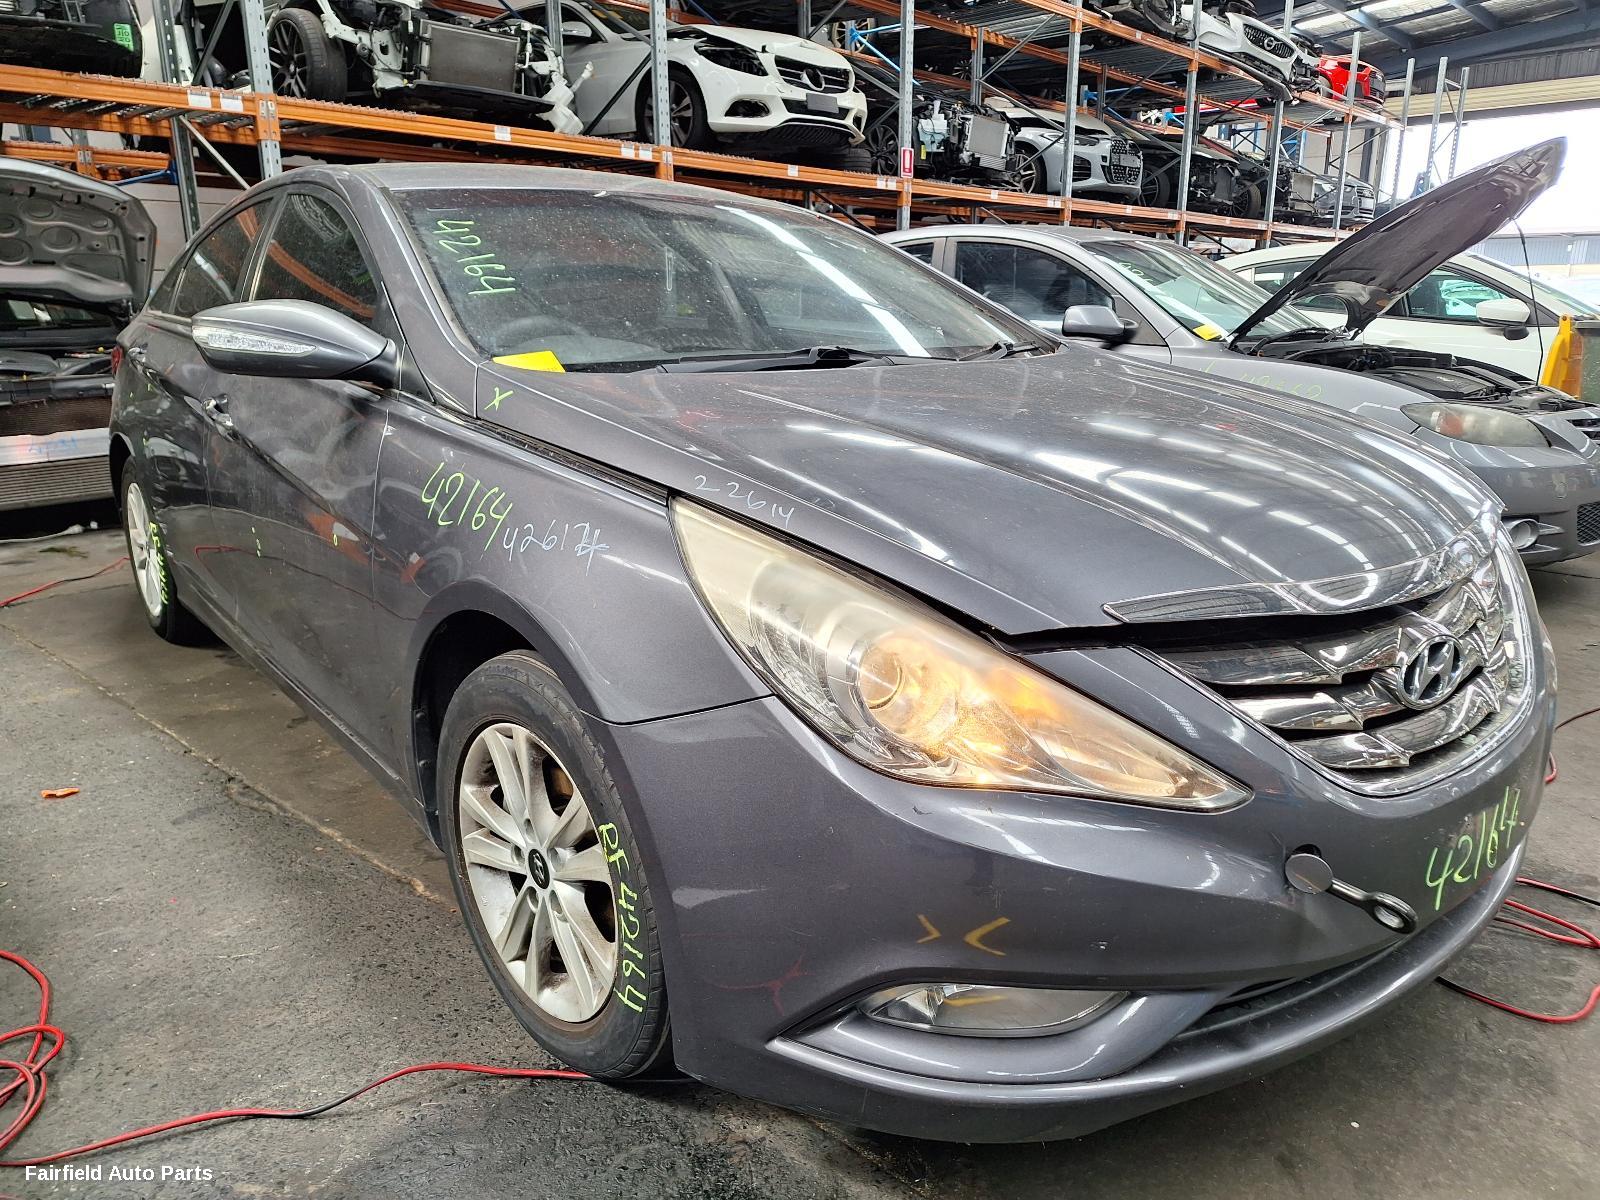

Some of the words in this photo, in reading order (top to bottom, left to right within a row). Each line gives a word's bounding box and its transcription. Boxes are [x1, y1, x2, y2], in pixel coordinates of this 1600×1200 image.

[432, 219, 516, 295] 42164
[421, 461, 513, 552] 42164
[1425, 785, 1521, 912] 42164
[612, 880, 647, 1013] 42164
